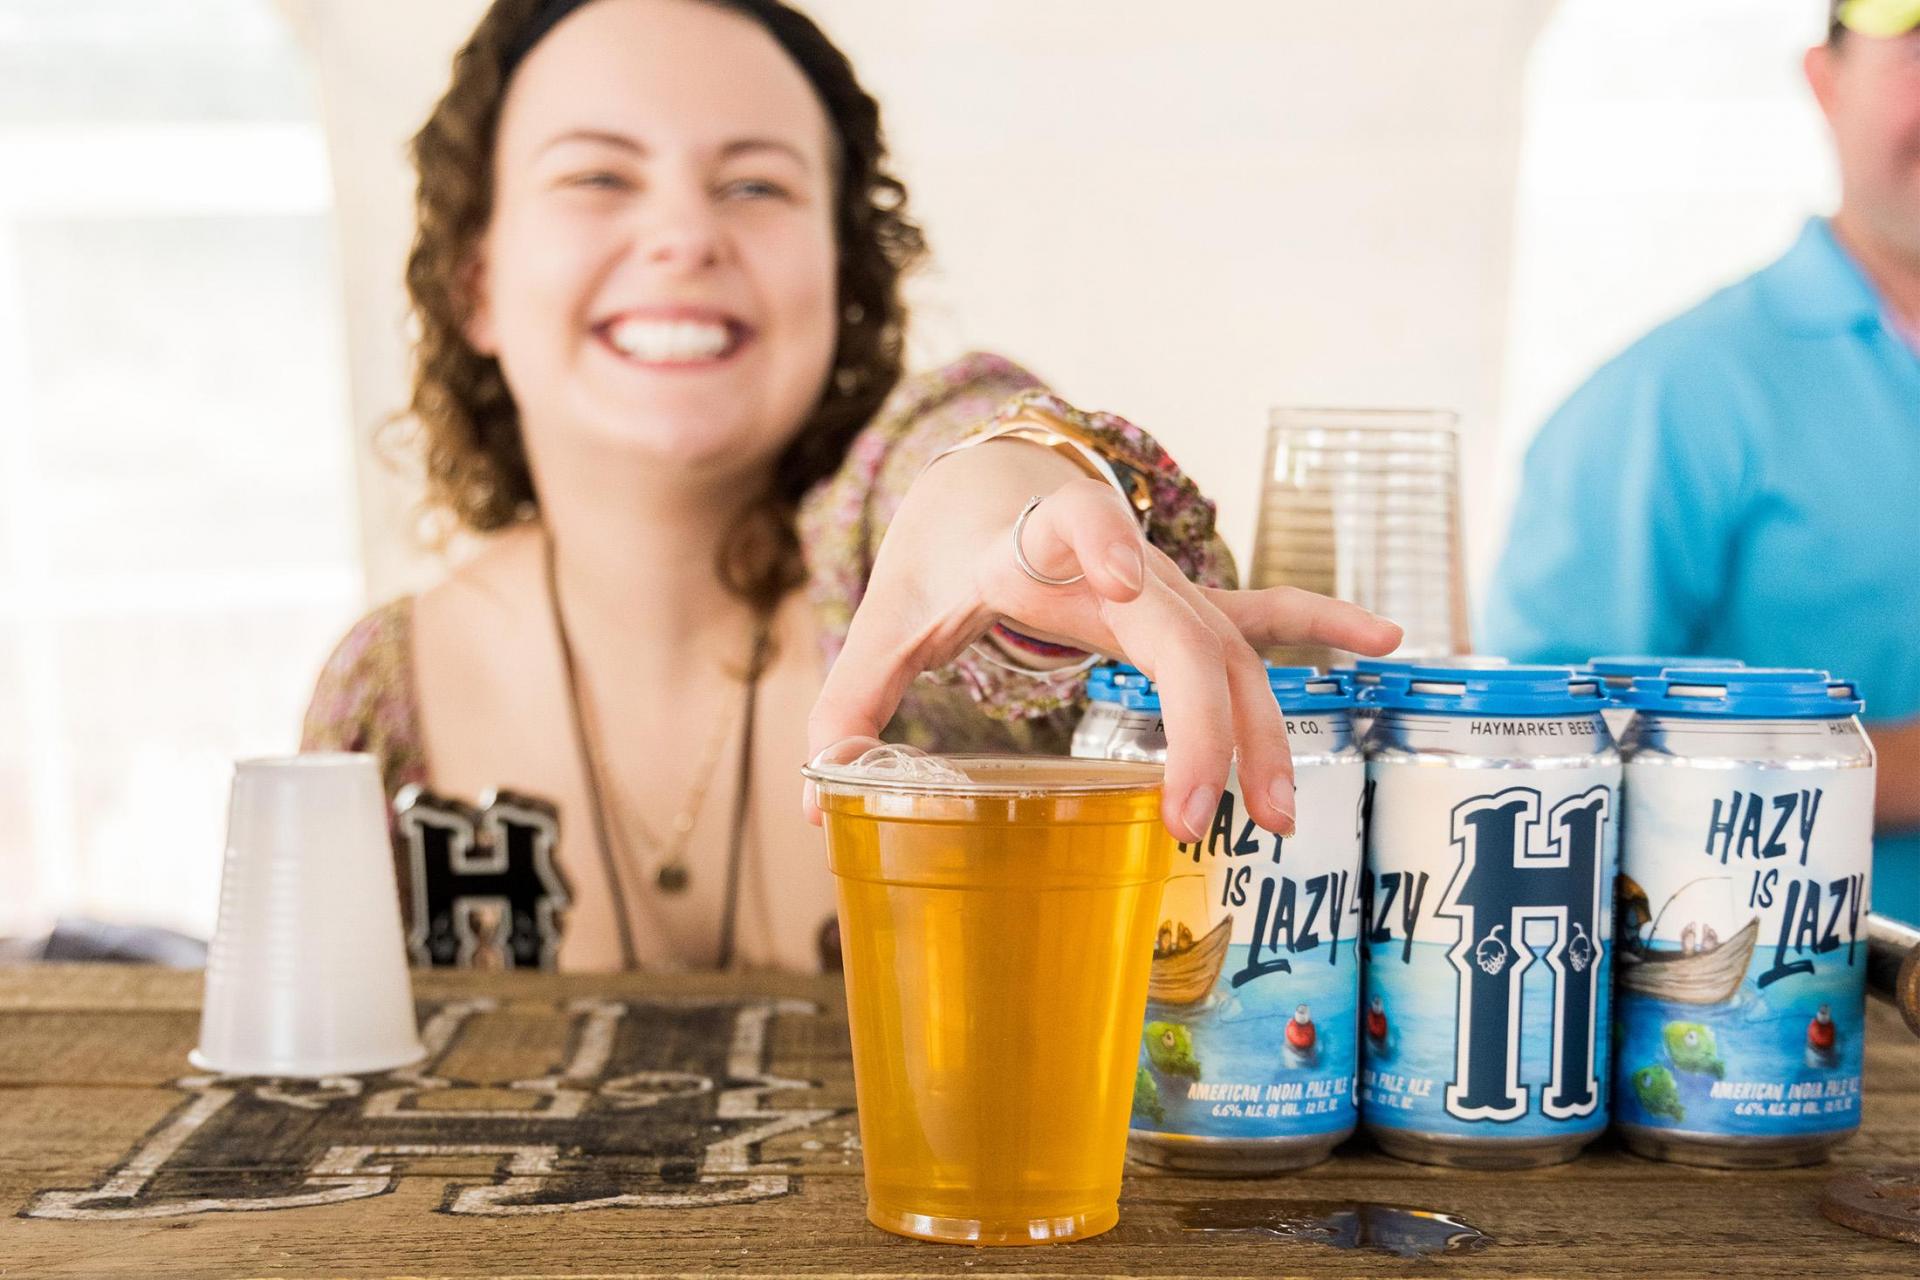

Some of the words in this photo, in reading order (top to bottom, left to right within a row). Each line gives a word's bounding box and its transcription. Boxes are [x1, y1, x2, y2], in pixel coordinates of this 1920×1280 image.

[1300, 721, 1323, 734] CO.
[1471, 721, 1563, 736] HAYMARKET
[1705, 788, 1822, 866] HAZY
[398, 799, 571, 971] H
[1221, 866, 1251, 906] IS
[1749, 868, 1778, 908] IS
[1232, 870, 1348, 989] LAZY
[1757, 872, 1864, 989] LAZY
[1433, 786, 1610, 1124] H
[1188, 1083, 1261, 1102] AMERICAN
[1266, 1082, 1303, 1100] INDIA
[1305, 1079, 1331, 1098] PALE
[1212, 1104, 1242, 1117] 6.6%
[1710, 1081, 1785, 1101] AMERICAN
